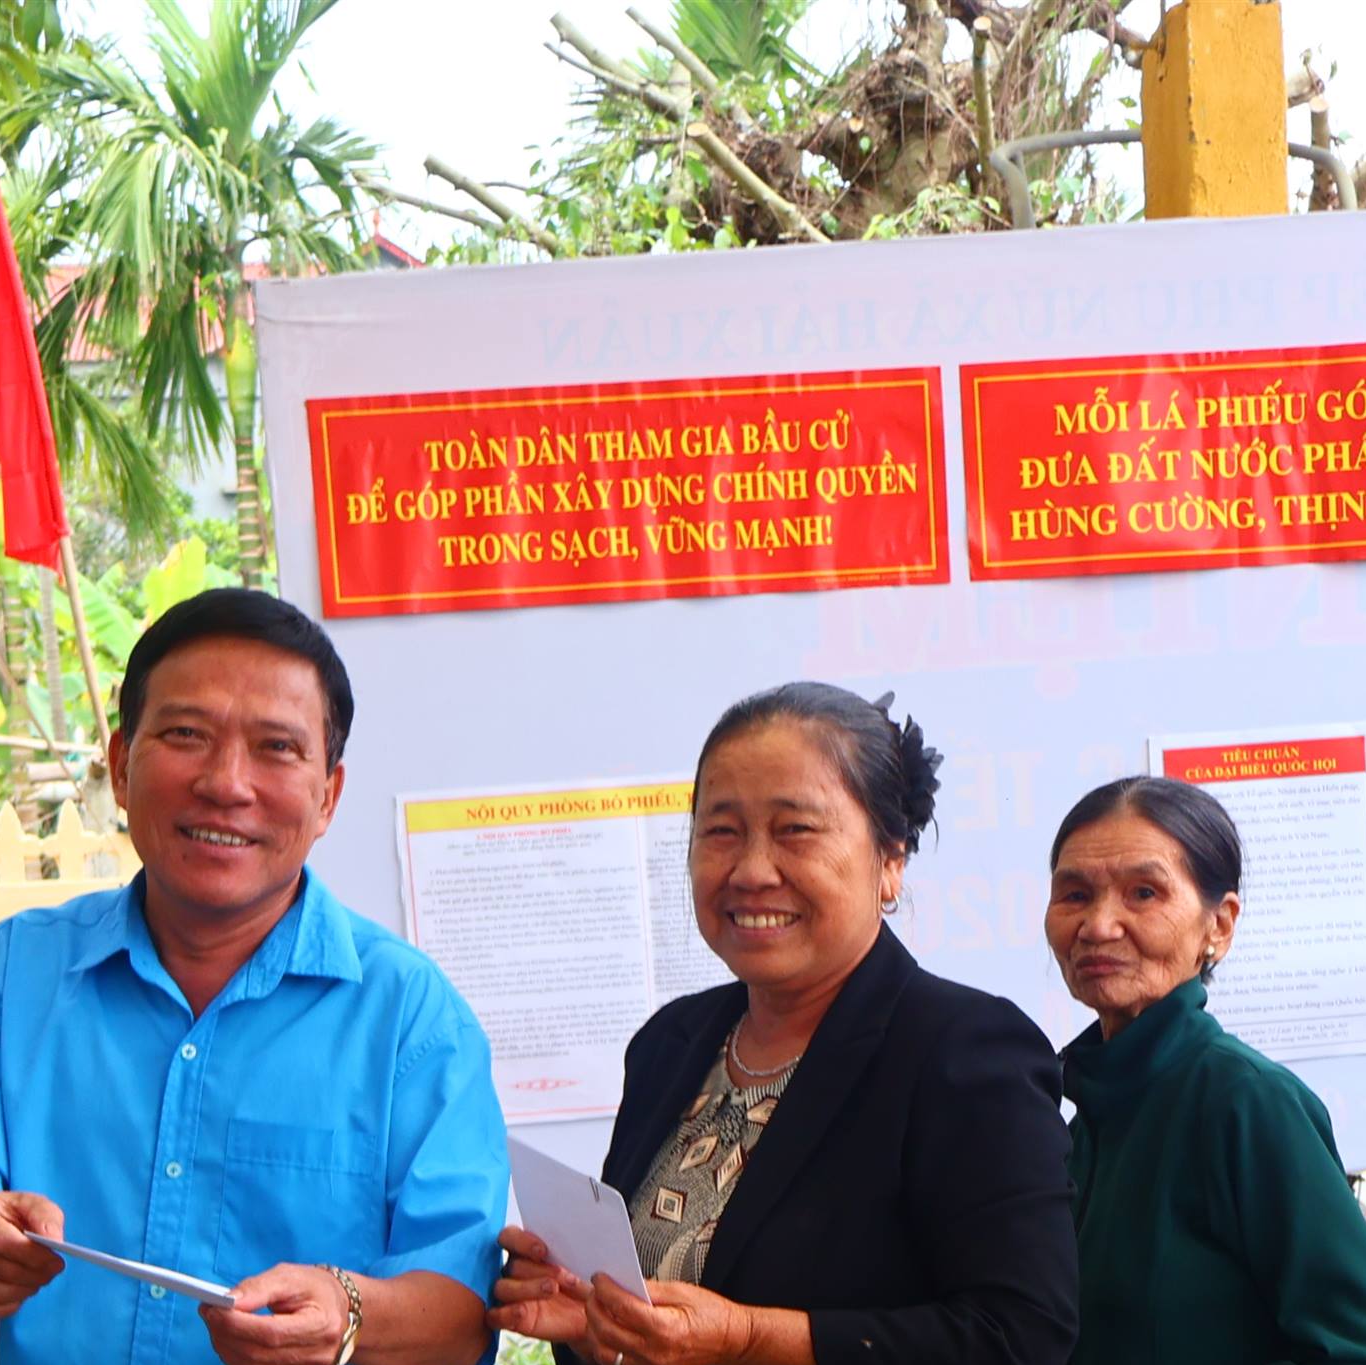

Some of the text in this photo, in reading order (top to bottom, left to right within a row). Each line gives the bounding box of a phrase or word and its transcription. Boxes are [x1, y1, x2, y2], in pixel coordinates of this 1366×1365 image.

[1054, 387, 1129, 436] MỖI
[1138, 390, 1186, 432] LÁ
[1195, 378, 1307, 429] PHIẾU
[424, 407, 850, 472] TOÀN DÂN THAM GIA BẦU CỬ
[1019, 450, 1099, 490] ĐƯA
[1107, 436, 1182, 484] ĐẤT
[1191, 436, 1294, 480] NƯỚC
[346, 449, 918, 525] ĐỂ GÓP PHẦN XÂY DỰNG CHÍNH QUYỀN
[438, 515, 834, 568] TRONG SẠCH, VỮNG MẠNH!
[1009, 499, 1118, 541] HÙNG
[1128, 491, 1267, 533] CƯỜNG,
[1185, 756, 1337, 780] CỦA ĐẠI BIỂU QUỐC HỘI
[1221, 744, 1300, 763] TIÊU CHUẨN
[466, 803, 496, 823] NỘI
[500, 804, 534, 821] QUY
[538, 796, 596, 816] PHÒNG
[601, 793, 623, 811] BỎ
[627, 787, 682, 810] PHIẾU,
